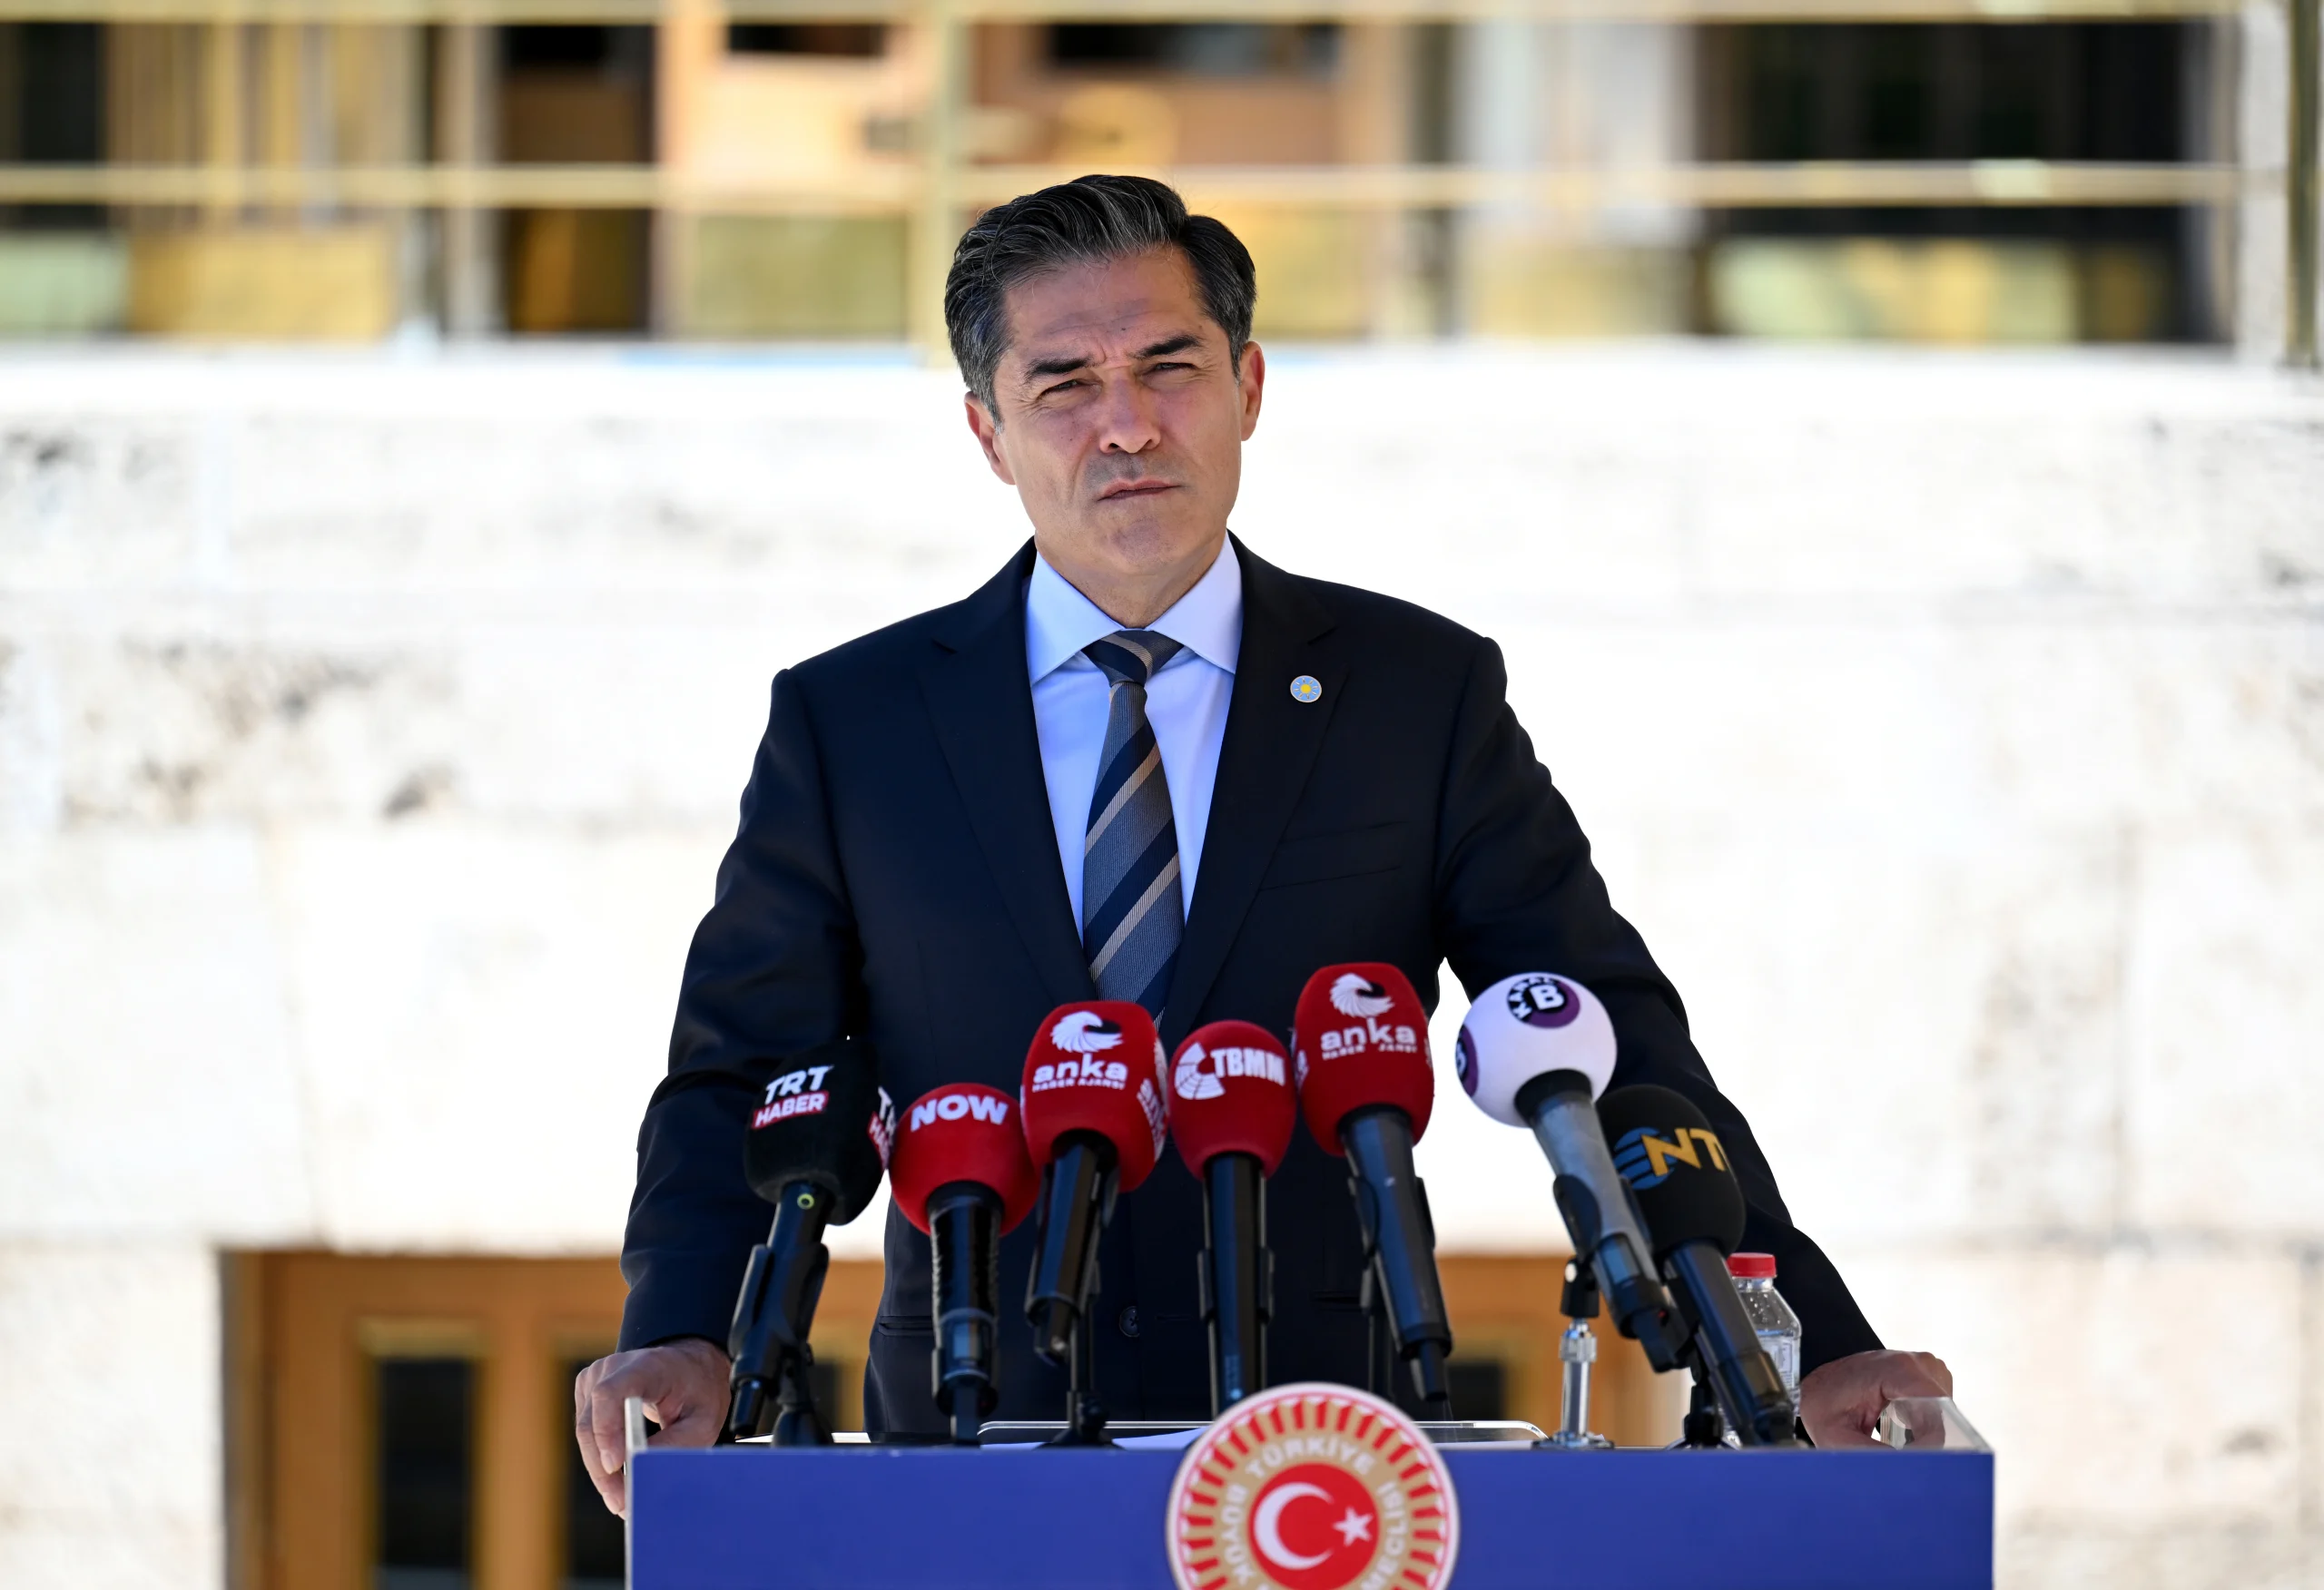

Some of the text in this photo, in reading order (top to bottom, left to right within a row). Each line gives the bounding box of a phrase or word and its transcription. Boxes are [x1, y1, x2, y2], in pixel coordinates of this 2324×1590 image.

[1530, 984, 1565, 1011] B
[1320, 1018, 1417, 1052] anka
[764, 1065, 834, 1104] TRT
[1032, 1053, 1128, 1085] anka
[1210, 1046, 1286, 1087] TBMM
[754, 1092, 826, 1124] HABER
[911, 1094, 1009, 1132] NOW
[1640, 1127, 1728, 1177] NT
